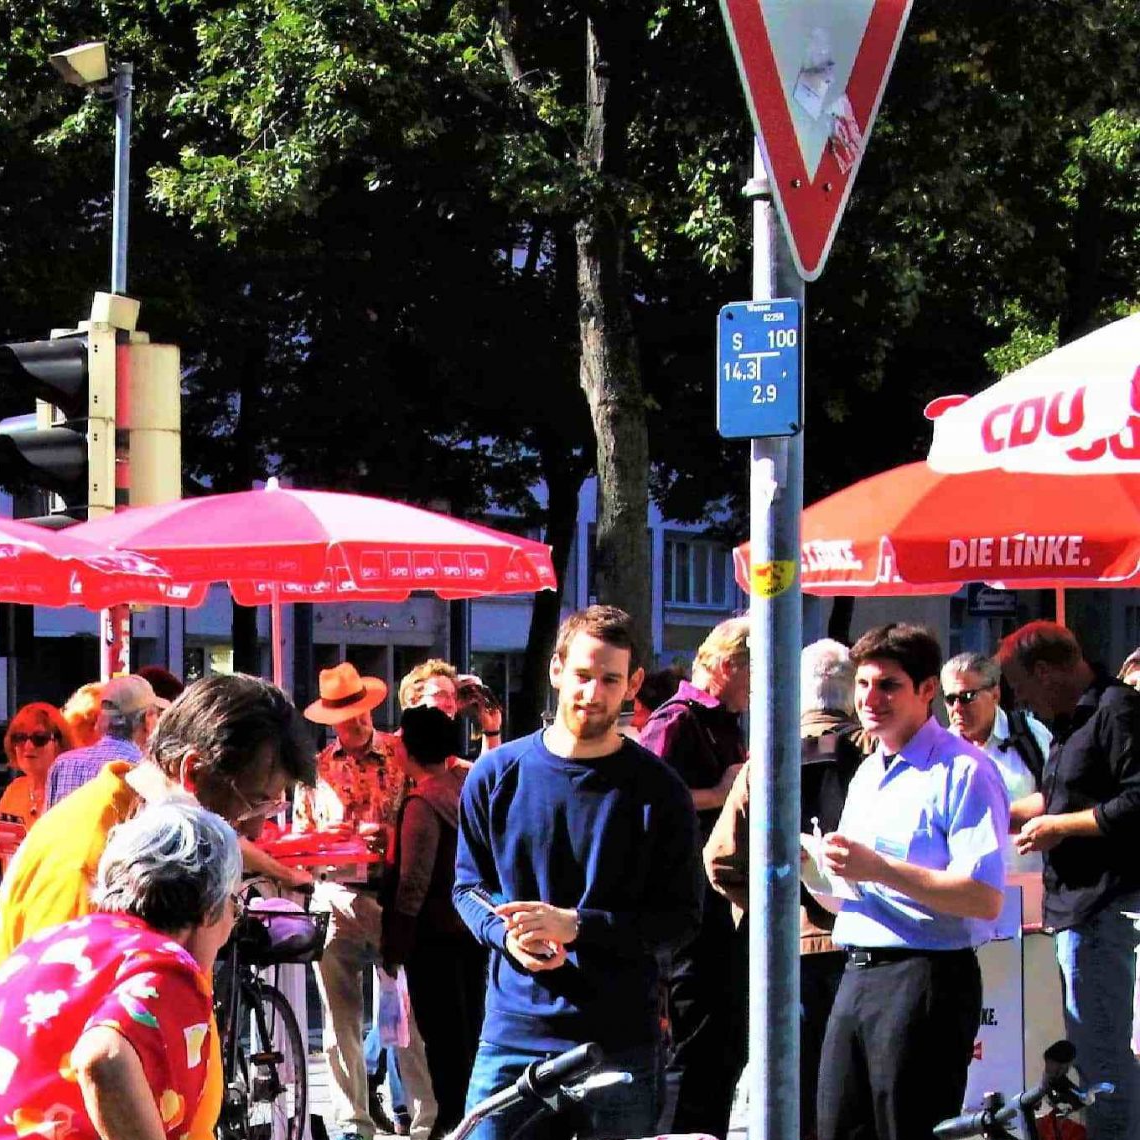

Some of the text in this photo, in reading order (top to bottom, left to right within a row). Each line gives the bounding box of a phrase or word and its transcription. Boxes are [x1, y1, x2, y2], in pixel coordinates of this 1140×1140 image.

[732, 328, 797, 351] S 100
[981, 386, 1086, 454] CDU
[948, 538, 995, 569] DIE
[391, 566, 408, 577] SPD
